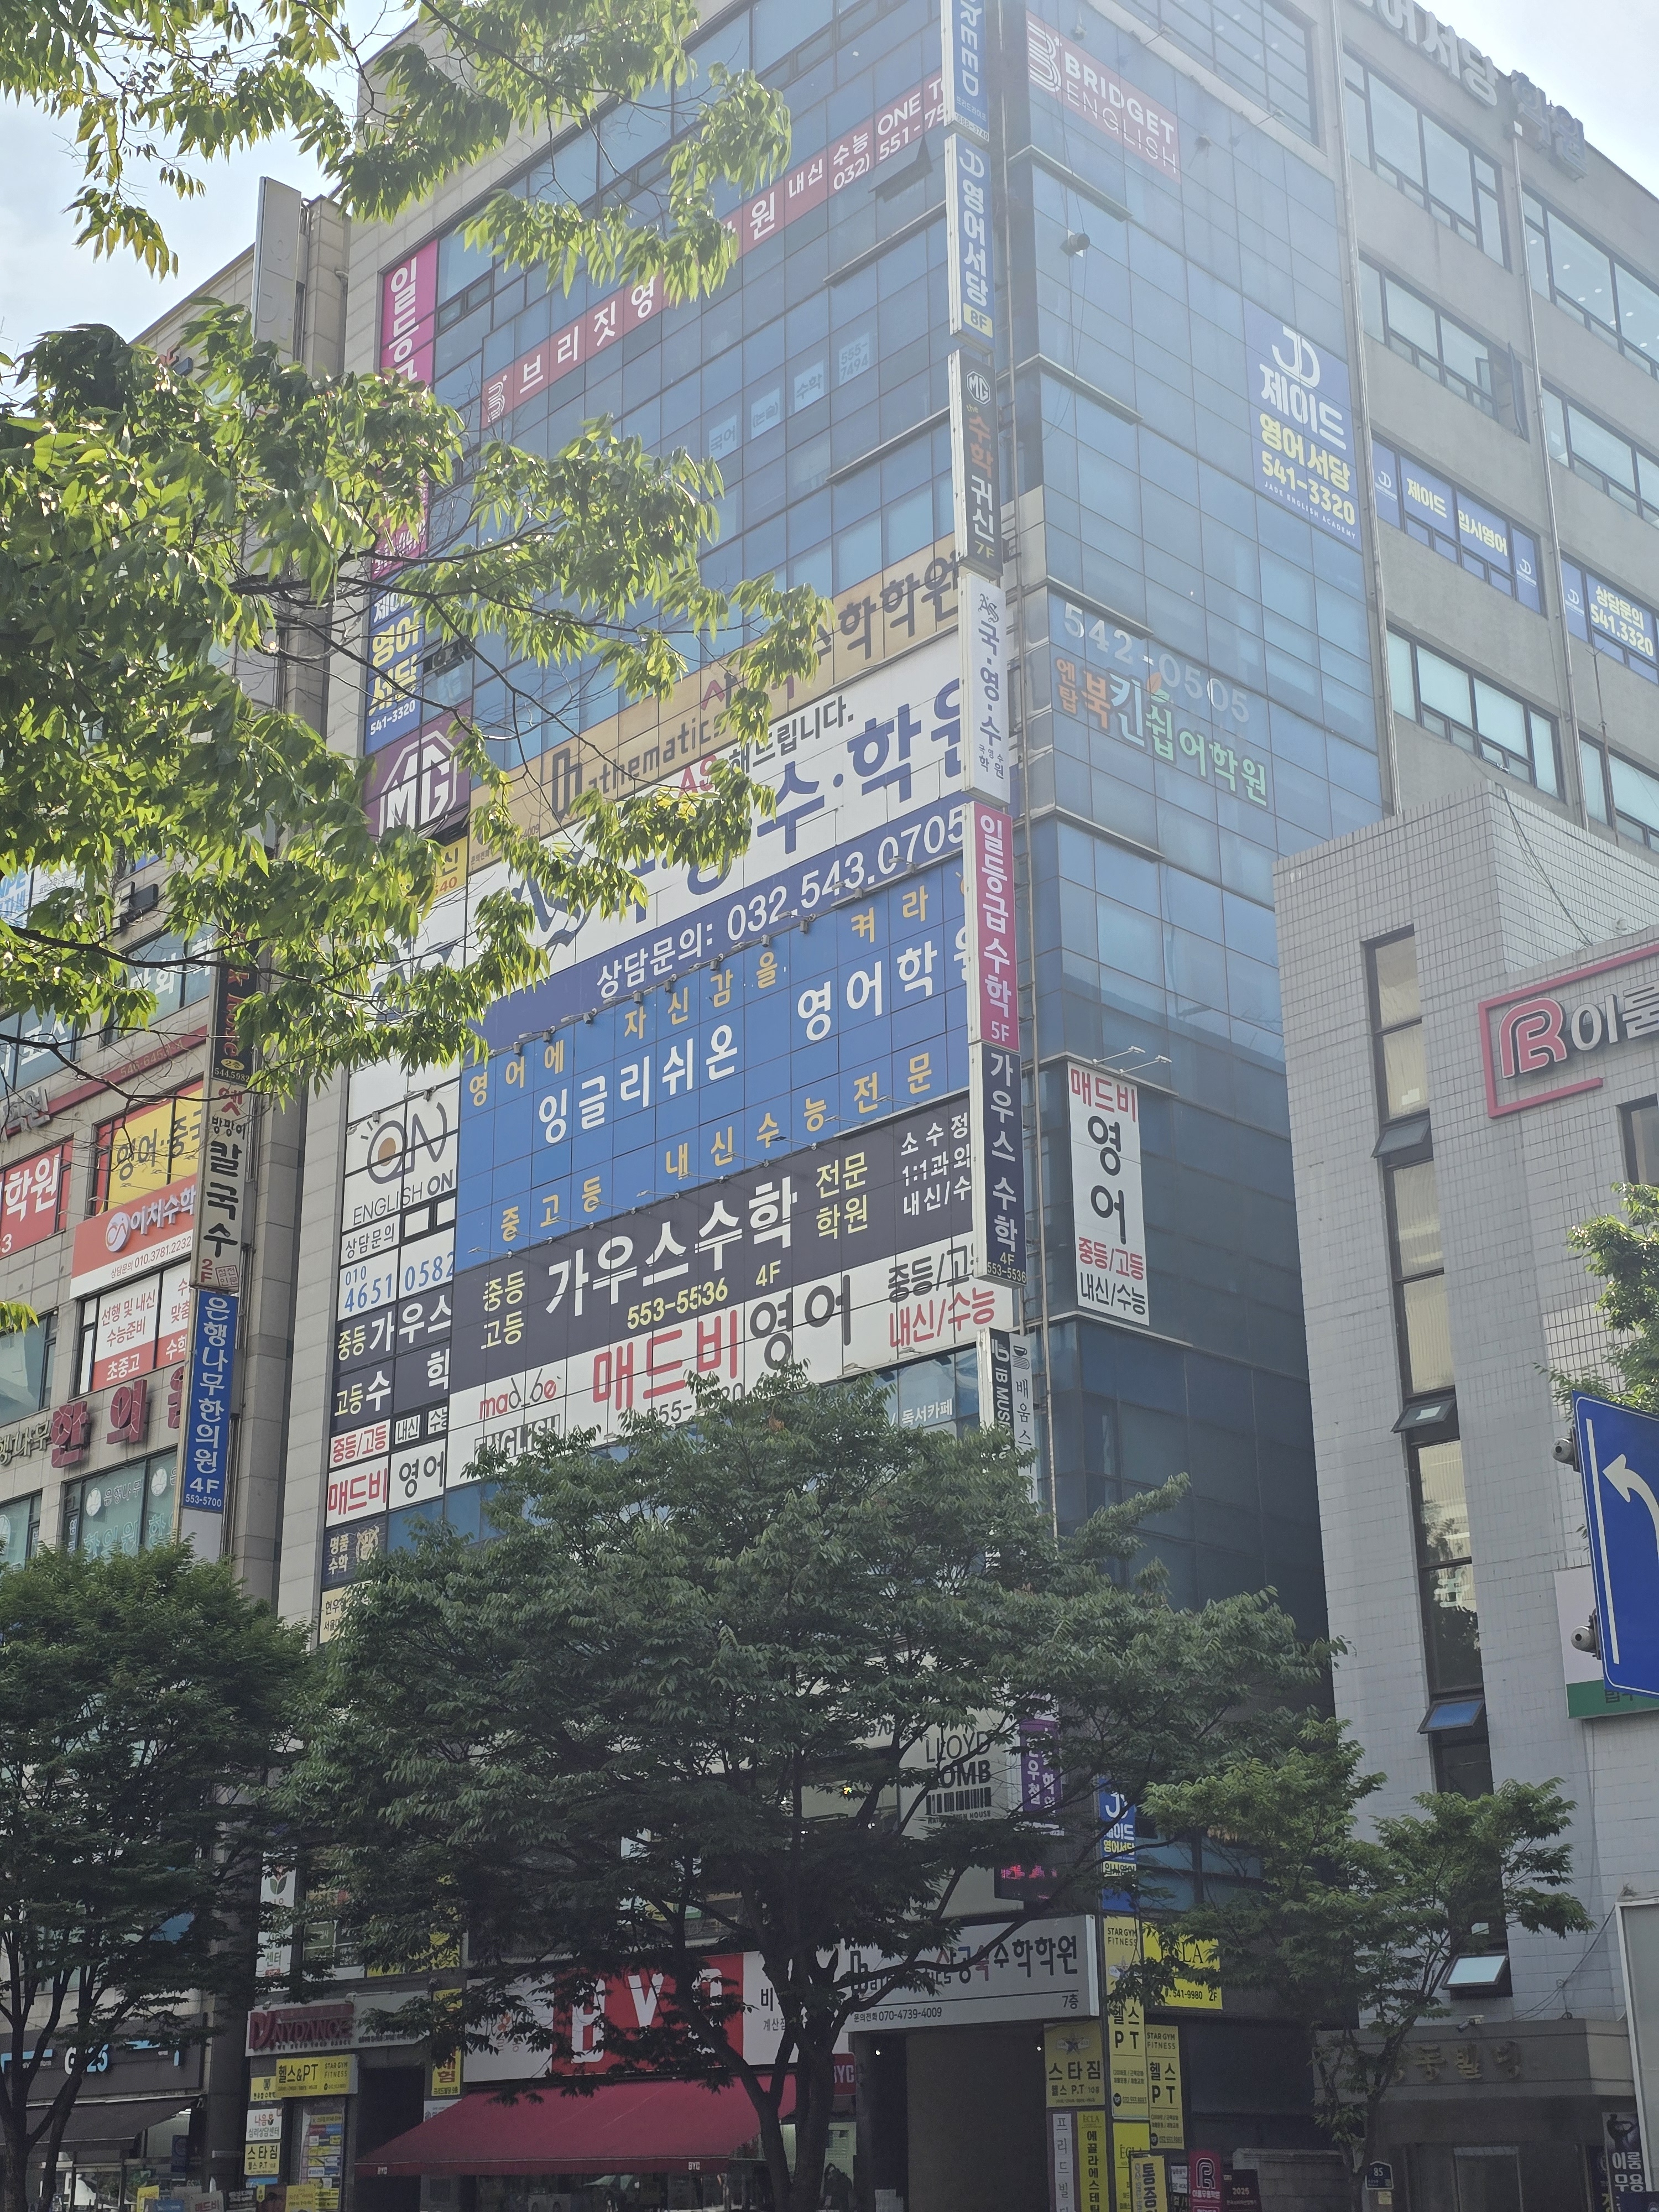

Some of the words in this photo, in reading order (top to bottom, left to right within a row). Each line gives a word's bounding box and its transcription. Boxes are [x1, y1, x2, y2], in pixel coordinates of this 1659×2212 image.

[959, 0, 983, 97] REED
[1065, 51, 1174, 144] BRIDGET
[1066, 79, 1177, 174] ENGLISH
[788, 159, 823, 199] 내신
[833, 129, 869, 168] 수능
[877, 92, 921, 135] ONE
[833, 153, 870, 191] 032)
[962, 178, 988, 307] 영어서당
[970, 309, 988, 329] 8F
[796, 373, 823, 400] 수학
[1258, 362, 1347, 450] 제이드
[1261, 450, 1355, 526] 541-3320
[1264, 481, 1284, 497] JADE
[1286, 493, 1320, 519] ENGLISH
[1321, 515, 1356, 540] ACADEMY
[1406, 477, 1448, 519] 제이드
[1458, 509, 1509, 557] 입시영어
[975, 541, 995, 559] 7F
[1595, 585, 1645, 631] 상담문의
[371, 610, 419, 667] 영어
[1590, 603, 1654, 658] 541.3320
[370, 700, 416, 736] 541-3320
[597, 927, 713, 998] 상담문의:
[727, 808, 964, 942] 032.543.0705
[469, 1040, 564, 1107] 영어에
[624, 950, 778, 1041] 자신감을
[851, 885, 929, 944] 켜라
[990, 1020, 1010, 1042] 5F
[214, 1067, 251, 1083] 544.5982
[539, 1024, 738, 1144] 잉글리쉬온
[218, 1087, 243, 1117] 옛
[990, 1051, 1015, 1162] 가우스
[1070, 1068, 1136, 1123] 매드비
[211, 1116, 247, 1141] 방망이
[4, 1154, 60, 1222] 학원
[353, 1182, 422, 1227] ENGLISH
[426, 1170, 453, 1197] ON
[1087, 1115, 1127, 1245] 영어
[203, 1140, 243, 1258] 칼국수
[500, 1176, 603, 1242] 중고등
[993, 1177, 1018, 1252] 수학
[345, 1223, 395, 1260] 상담문의
[482, 1270, 525, 1312] 중등
[545, 1176, 797, 1318] 가우스수학
[816, 1151, 868, 1199] 전문
[111, 1261, 133, 1279] 상담문의
[134, 1235, 192, 1269] 010.3781.2232
[200, 1259, 213, 1283] 2F
[481, 1311, 525, 1350] 고등
[816, 1193, 868, 1240] 학원
[987, 1261, 1027, 1284] 553-5536
[1000, 1252, 1015, 1266] 4F
[1078, 1237, 1144, 1281] 중등/고등
[344, 1273, 393, 1313] 4651
[345, 1265, 367, 1287] 010
[1081, 1272, 1146, 1316] 내신/수능
[101, 1304, 122, 1327] 선행
[123, 1300, 133, 1317] 및
[135, 1288, 155, 1312] 내신
[627, 1277, 728, 1330] 553-5536
[755, 1260, 781, 1287] 4F
[106, 1318, 145, 1347] 수능준비
[338, 1328, 366, 1362] 중등
[368, 1295, 452, 1353] 가우스
[889, 1287, 995, 1348] 내신/수능
[106, 1353, 140, 1383] 초중고
[193, 1297, 231, 1474] 은행나무한의원
[334, 1383, 364, 1417] 고등
[901, 1399, 953, 1426] 독서카페
[333, 1424, 387, 1464] 중등/고등
[397, 1413, 420, 1443] 내신
[103, 1480, 143, 1507] 은행나무
[185, 1494, 222, 1508] 553-5700
[190, 1477, 220, 1495] 4F
[328, 1468, 388, 1515] 매드비
[399, 1451, 444, 1499] 영어
[328, 1554, 348, 1575] 수학
[969, 1810, 991, 1819] HOUSE
[1108, 1927, 1123, 1936] STAR
[1108, 1937, 1137, 1947] FITNESS
[853, 2012, 878, 2023] 문의전화
[878, 2007, 942, 2022] 070-4739-4009
[1061, 1994, 1079, 2009] 7층
[1146, 2032, 1162, 2041] STAR
[1162, 2032, 1176, 2041] GYM
[1147, 2041, 1176, 2050] FITNESS
[278, 2063, 319, 2084] 헬스&PT
[324, 2070, 348, 2079] FITNESS
[1048, 2060, 1101, 2081] 스타짐
[1149, 2061, 1176, 2081] 헬스
[254, 2114, 267, 2126] 나음
[247, 2145, 278, 2160] 스타짐
[1611, 2152, 1642, 2170] 이룸
[1373, 2167, 1384, 2177] 85
[1614, 2174, 1644, 2193] 무용
[1232, 2187, 1250, 2195] 2025
